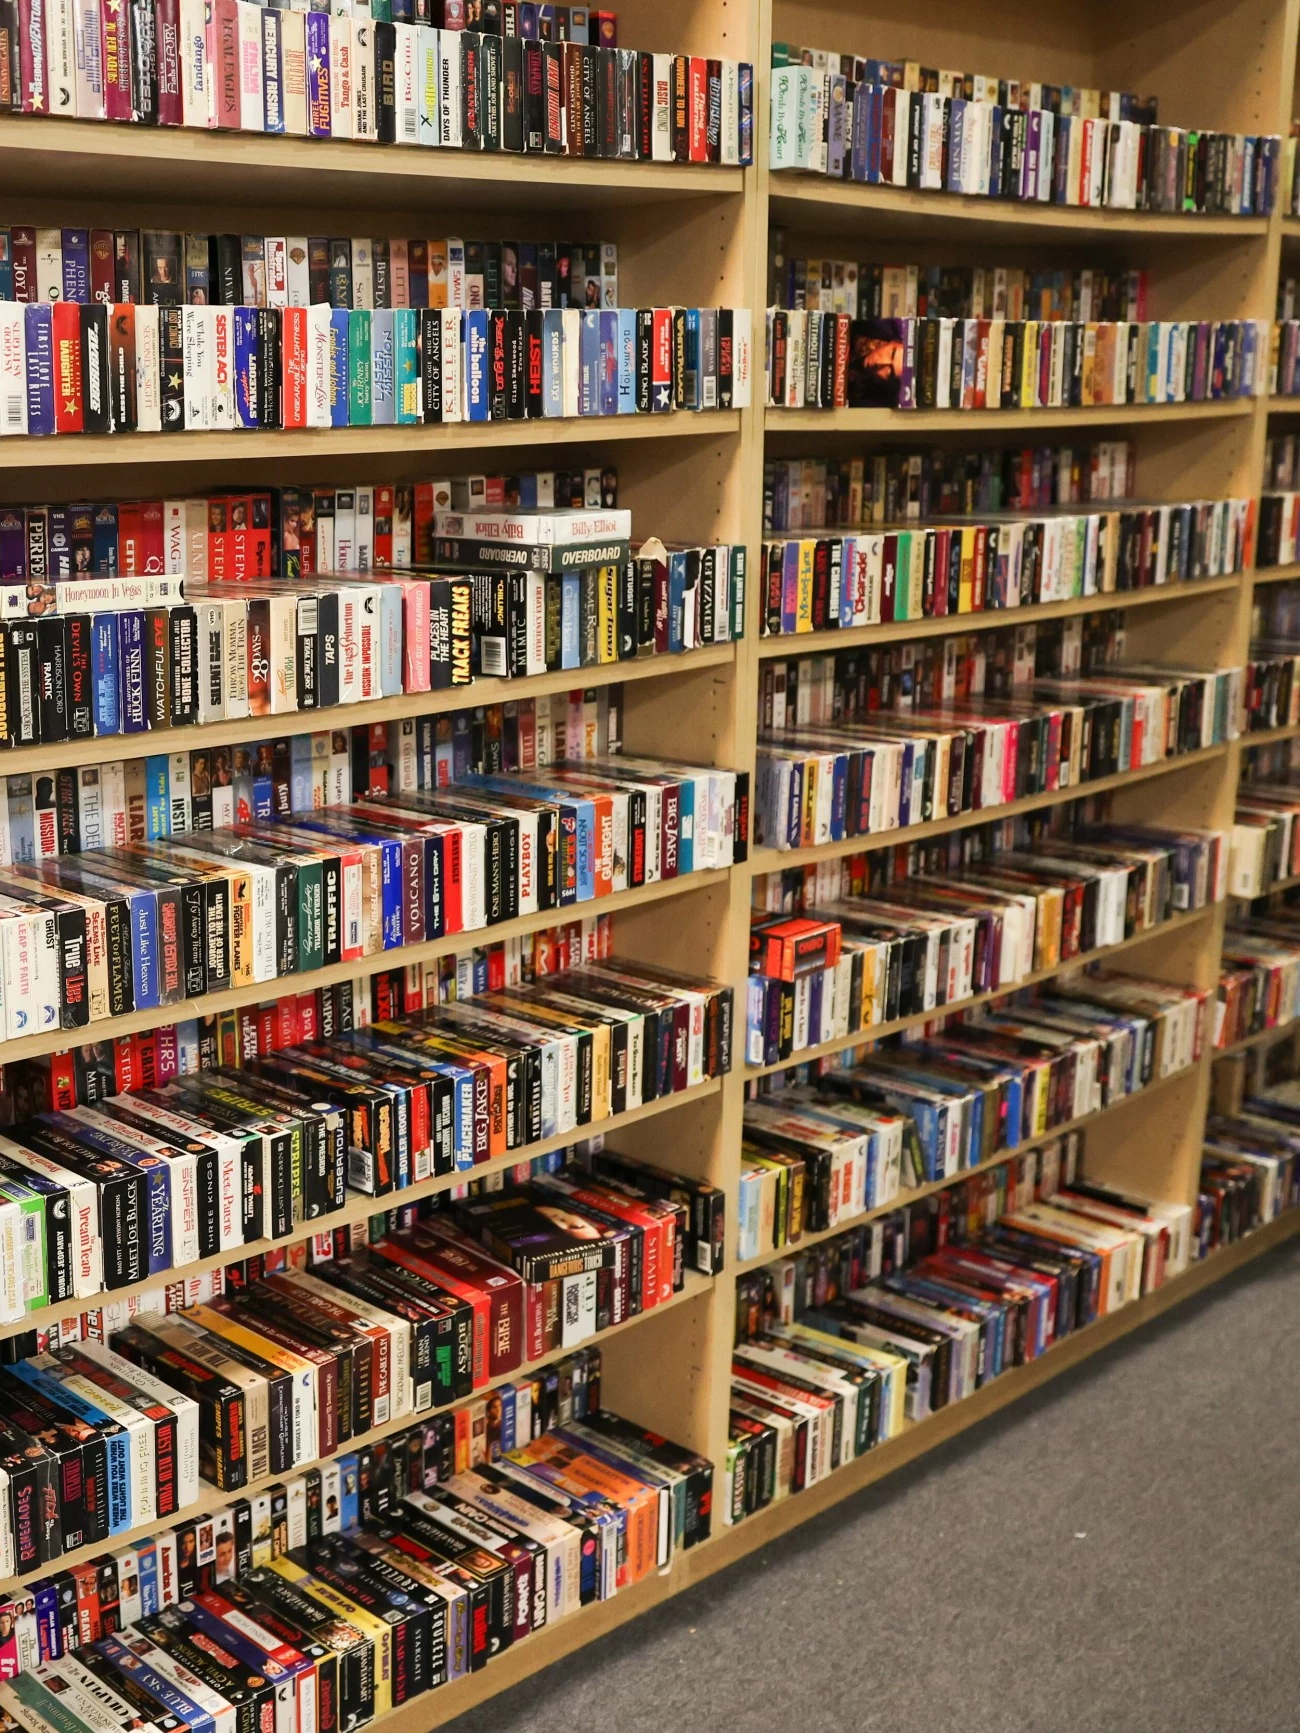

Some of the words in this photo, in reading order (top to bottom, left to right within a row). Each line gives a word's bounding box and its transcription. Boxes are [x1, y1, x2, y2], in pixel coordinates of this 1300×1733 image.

[194, 36, 203, 92] fandango
[264, 16, 276, 79] MERCURY
[319, 68, 329, 129] FUGITIVES
[382, 61, 394, 105] BIRD
[657, 81, 668, 105] BASIC
[266, 82, 278, 125] RISING
[658, 107, 668, 132] INSTINCT
[186, 335, 194, 376] Sleeping
[445, 320, 454, 414] KILLER
[530, 335, 541, 395] HEIST
[837, 319, 848, 407] ENTRAPMENT
[249, 354, 257, 419] STAKEOUT
[475, 521, 499, 537] Elliot
[502, 521, 524, 538] Billy
[479, 548, 527, 563] OVERBOARD
[562, 547, 621, 564] OVERBOARD
[831, 545, 840, 564] THE
[452, 585, 470, 637] FREAKS
[829, 566, 839, 618] CHAMBER
[229, 621, 237, 664] MOMMA
[452, 639, 470, 684] TRACK
[130, 649, 141, 684] FINN
[229, 666, 237, 701] THROW
[131, 687, 142, 722] HUCK
[667, 798, 677, 825] BIG
[521, 832, 532, 899] PLAYBOY
[665, 825, 678, 869] JAKE
[328, 870, 337, 954] TRAFFIC
[411, 854, 420, 933] VOLCANO
[492, 898, 500, 917] ONE
[138, 909, 148, 933] Just
[65, 935, 84, 969] True
[140, 935, 148, 955] Like
[66, 975, 84, 1004] Lies
[141, 958, 150, 997] Heaven
[461, 1083, 473, 1162] PEACEMAKER
[291, 1130, 301, 1198] STRIPES
[126, 1180, 138, 1218] BLACK
[79, 1206, 91, 1249] Dream
[128, 1221, 139, 1249] JOE
[151, 1184, 165, 1258] YEARLING
[80, 1249, 92, 1279] Team
[128, 1251, 139, 1280] MEET
[550, 1258, 584, 1279] DANGEROUS
[585, 1249, 603, 1270] TOUCH
[457, 1321, 467, 1375] BUGSY
[252, 1425, 267, 1453] MEN
[252, 1455, 268, 1478] TIN
[533, 1592, 546, 1628] CAIN
[432, 1611, 444, 1668] SQUEEZE
